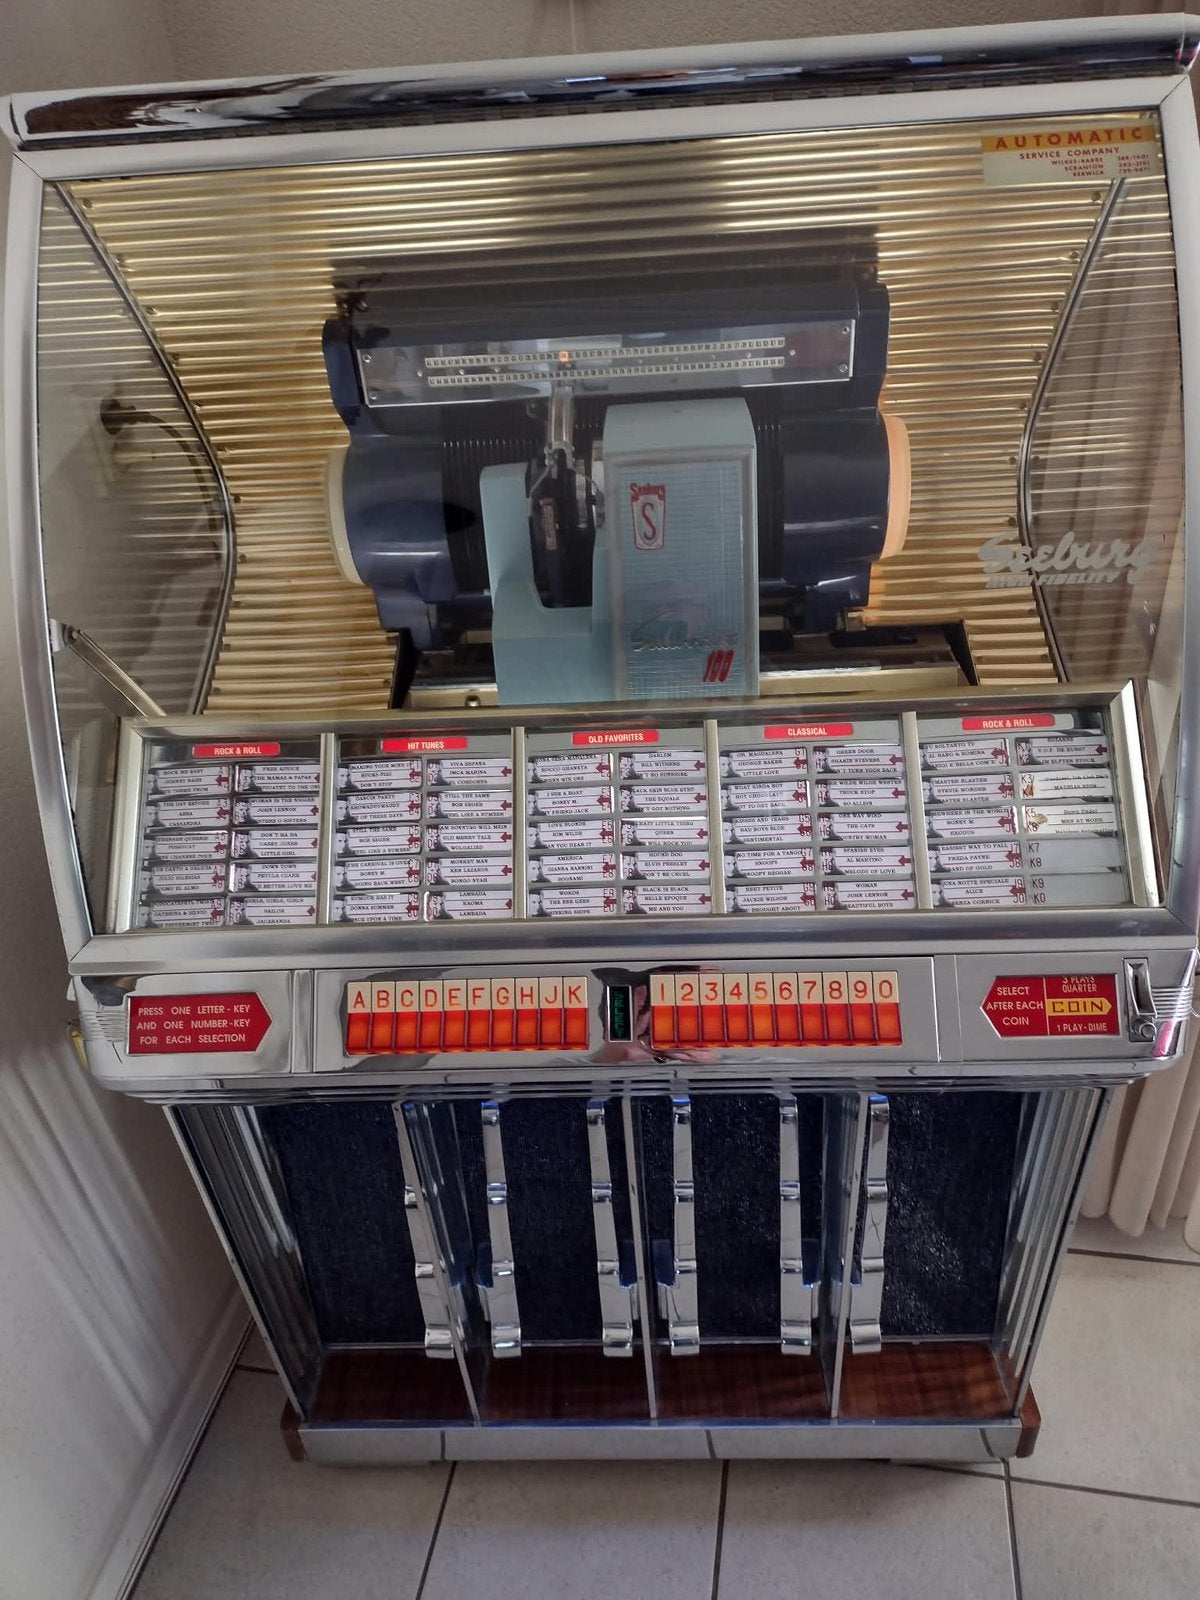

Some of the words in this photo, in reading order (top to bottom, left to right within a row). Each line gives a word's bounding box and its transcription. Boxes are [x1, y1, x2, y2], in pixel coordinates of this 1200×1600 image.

[995, 127, 1144, 150] AUTOMATIC
[1019, 150, 1061, 160] SERVICE
[1066, 146, 1120, 157] COMPANY
[977, 530, 1154, 585] Seeburg
[982, 720, 1004, 729] ROCK
[1005, 720, 1012, 728] &
[1013, 718, 1035, 727] ROLL
[787, 727, 828, 736] CLASSICAL
[588, 735, 603, 744] OLD
[604, 732, 644, 743] FAVORITES
[407, 742, 420, 750] HIT
[421, 741, 445, 750] TUNES
[214, 747, 234, 756] ROCK
[235, 747, 241, 755] &
[242, 746, 262, 754] ROLL
[1021, 774, 1033, 784] K3
[1025, 808, 1036, 818] K5
[1028, 842, 1040, 852] K7
[1029, 858, 1042, 867] K8
[1032, 878, 1044, 889] K9
[1062, 976, 1068, 984] 3
[1070, 975, 1095, 984] PLAYS
[680, 983, 695, 1001] 2
[705, 982, 718, 1001] 3
[729, 982, 743, 1000] 4
[754, 981, 768, 1000] 5
[779, 981, 793, 1000] 6
[803, 981, 817, 999] 7
[829, 980, 843, 999] 8
[853, 980, 867, 999] 9
[879, 979, 893, 999] 0
[997, 986, 1030, 996] SELECT
[1062, 983, 1097, 993] QUARTER
[353, 991, 366, 1009] A
[377, 990, 390, 1009] B
[400, 990, 413, 1008] C
[425, 989, 438, 1008] D
[448, 988, 461, 1007] E
[472, 987, 485, 1006] F
[496, 987, 510, 1005] G
[520, 986, 534, 1005] H
[544, 986, 558, 1004] J
[568, 985, 582, 1004] K
[986, 1001, 1014, 1011] AFTER
[1016, 1000, 1044, 1010] EACH
[1051, 1000, 1104, 1013] COIN
[138, 1007, 164, 1016] PRESS
[170, 1006, 191, 1015] ONE
[136, 1021, 157, 1031] AND
[163, 1021, 184, 1030] ONE
[1002, 1016, 1030, 1026] COIN
[1057, 1024, 1061, 1032] 1
[140, 1036, 158, 1045] FOR
[166, 1035, 192, 1044] EACH
[198, 1033, 246, 1043] SELECTION
